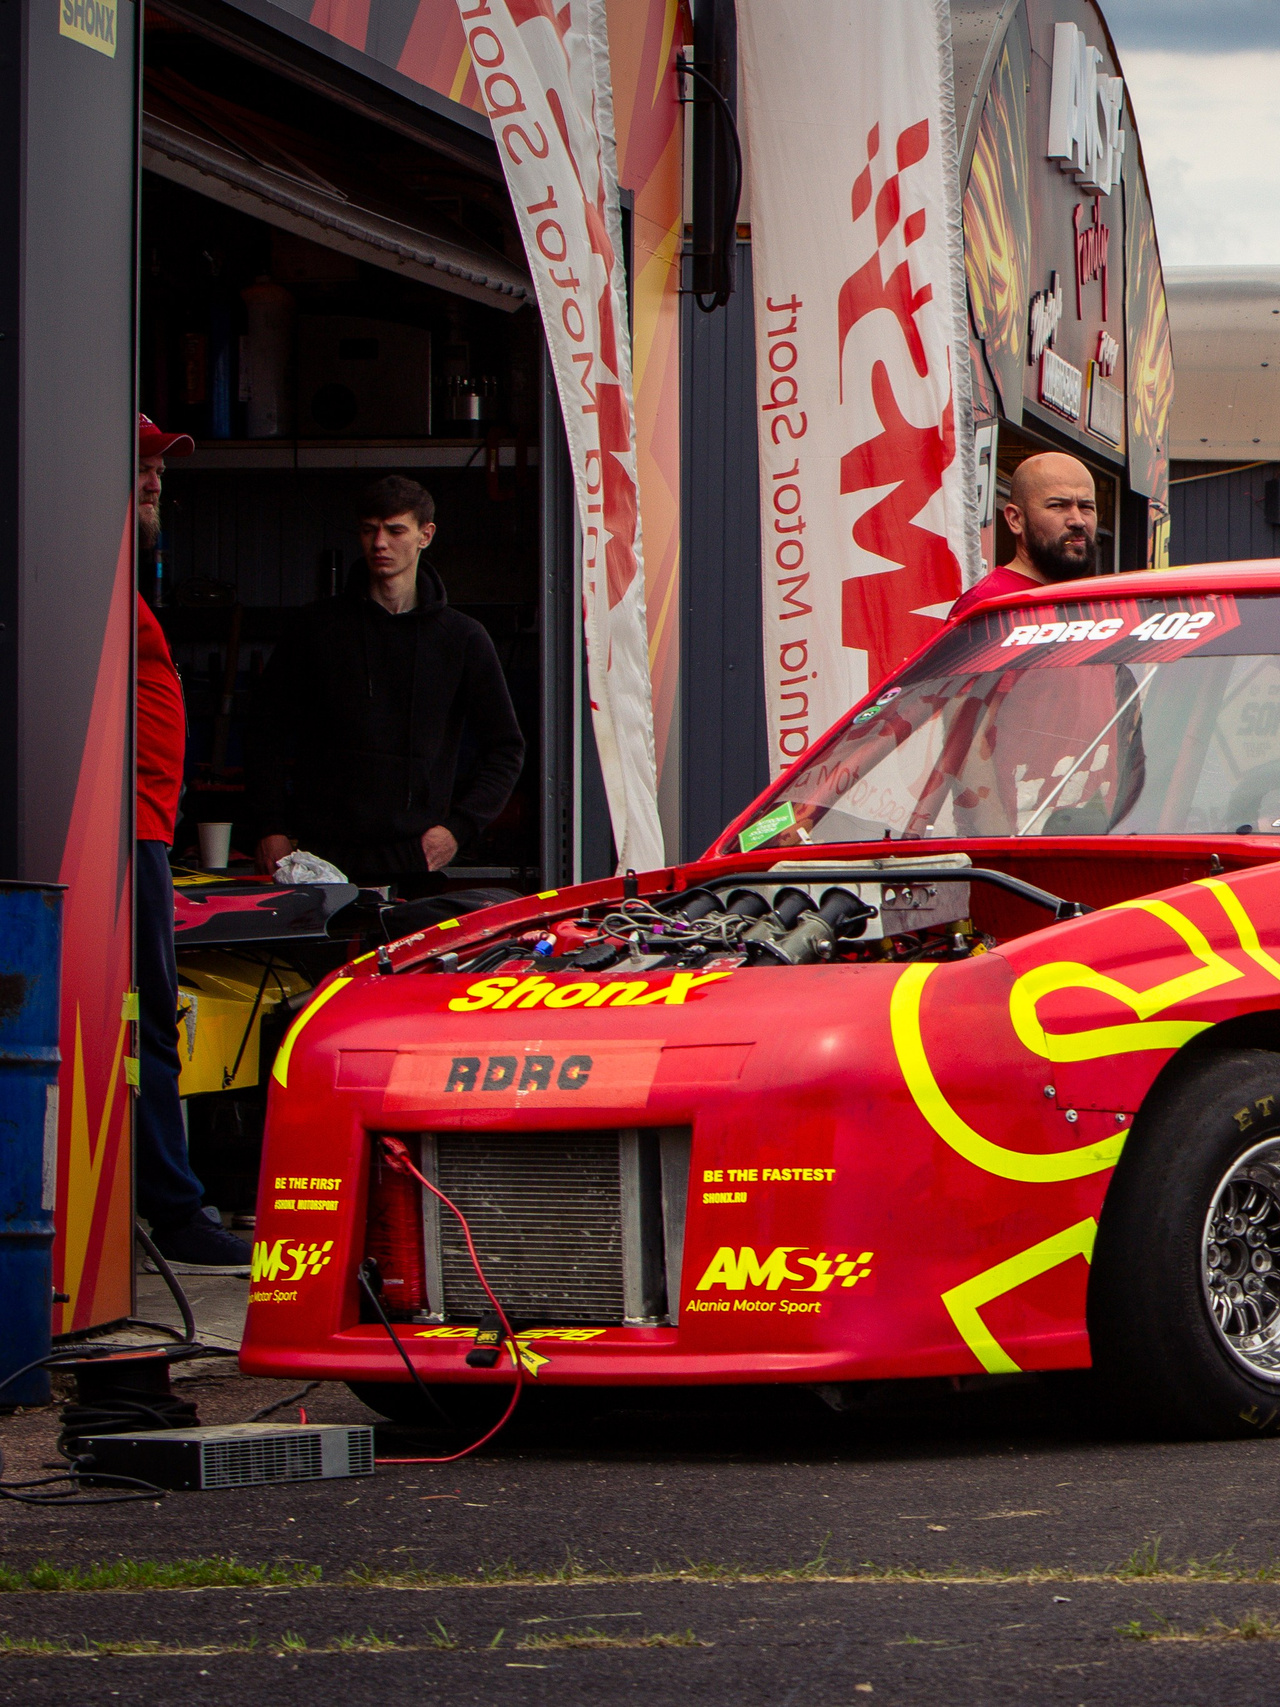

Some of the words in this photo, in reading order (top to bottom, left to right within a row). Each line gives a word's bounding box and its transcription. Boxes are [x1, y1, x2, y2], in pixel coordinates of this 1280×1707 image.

[63, 0, 115, 46] SHONX
[1000, 616, 1125, 648] RDRC
[1129, 610, 1216, 642] 402
[448, 972, 733, 1012] ShonX
[443, 1054, 594, 1093] RDRC
[1231, 1095, 1276, 1133] ET
[274, 1177, 288, 1190] BE
[288, 1177, 308, 1190] THE
[309, 1178, 342, 1191] FIRST
[703, 1170, 723, 1183] BE
[727, 1168, 759, 1182] THE
[762, 1168, 836, 1181] FASTEST
[702, 1192, 748, 1204] SHONX.RU
[273, 1289, 298, 1304] Sport
[685, 1299, 730, 1313] Alania
[733, 1299, 777, 1313] Motor
[779, 1299, 823, 1315] Sport
